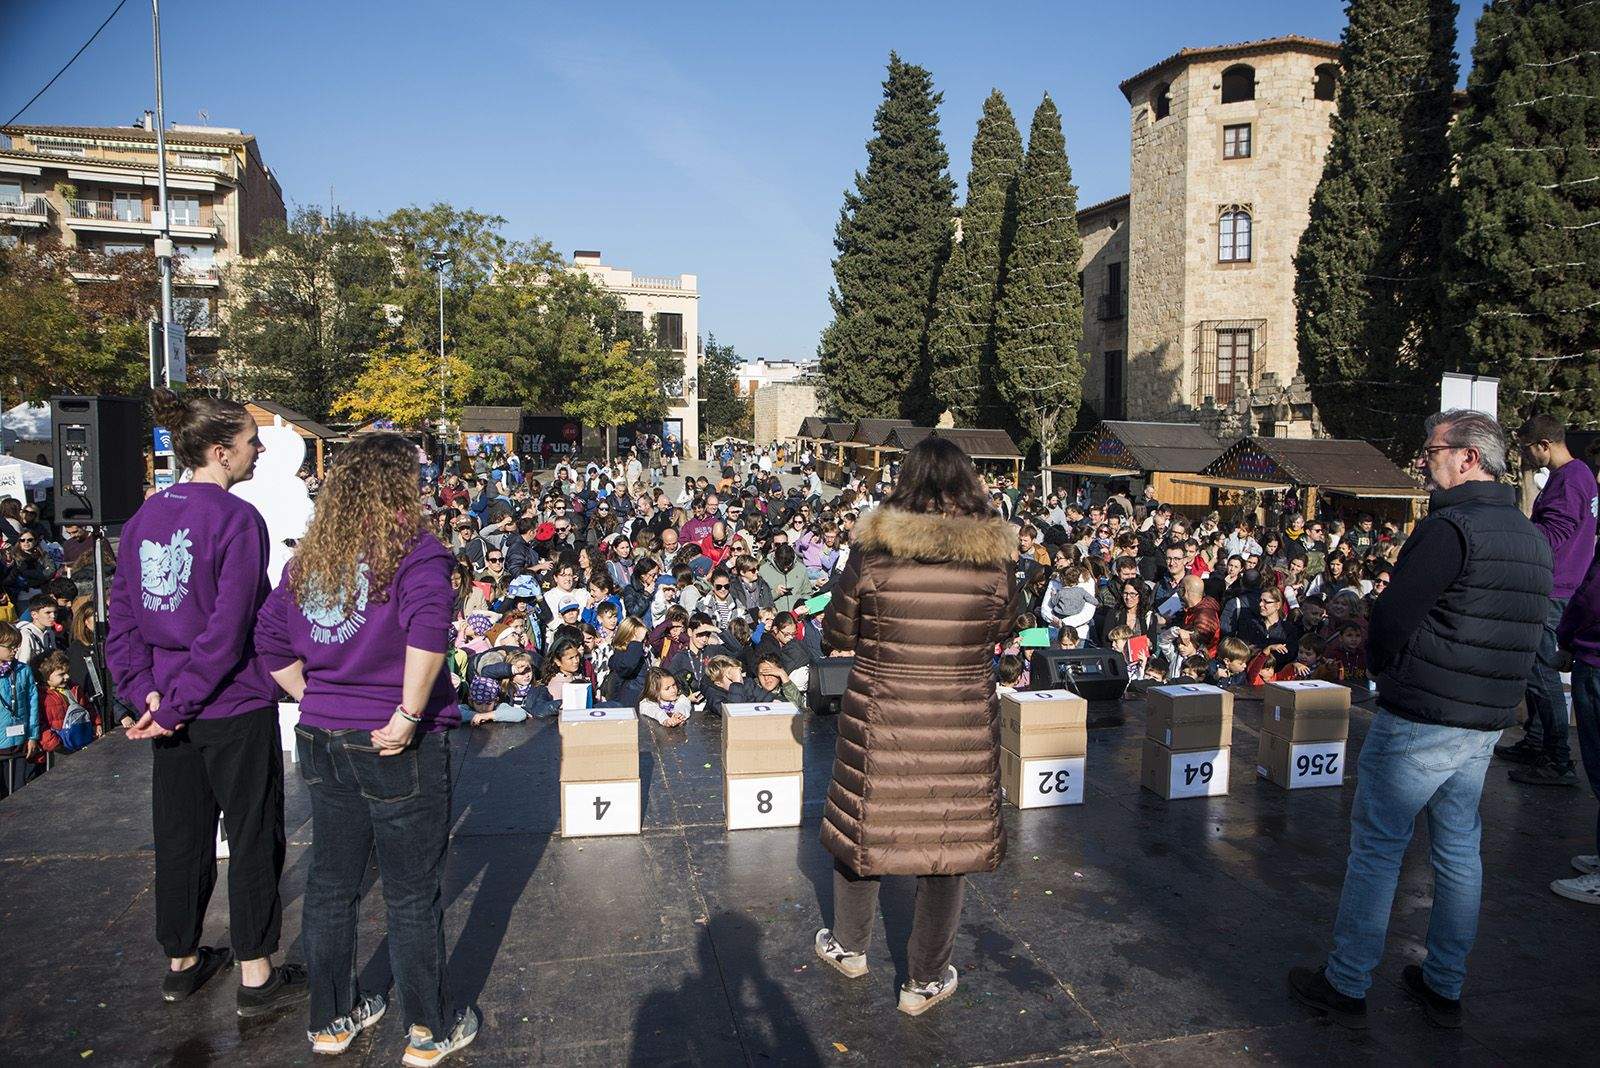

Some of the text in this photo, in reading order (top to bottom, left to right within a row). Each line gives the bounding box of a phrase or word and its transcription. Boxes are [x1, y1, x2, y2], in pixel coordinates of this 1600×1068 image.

[1184, 762, 1213, 786] 64
[1296, 753, 1338, 776] 256
[1038, 770, 1070, 795] 32
[593, 796, 611, 820] 4
[756, 790, 773, 814] 8
